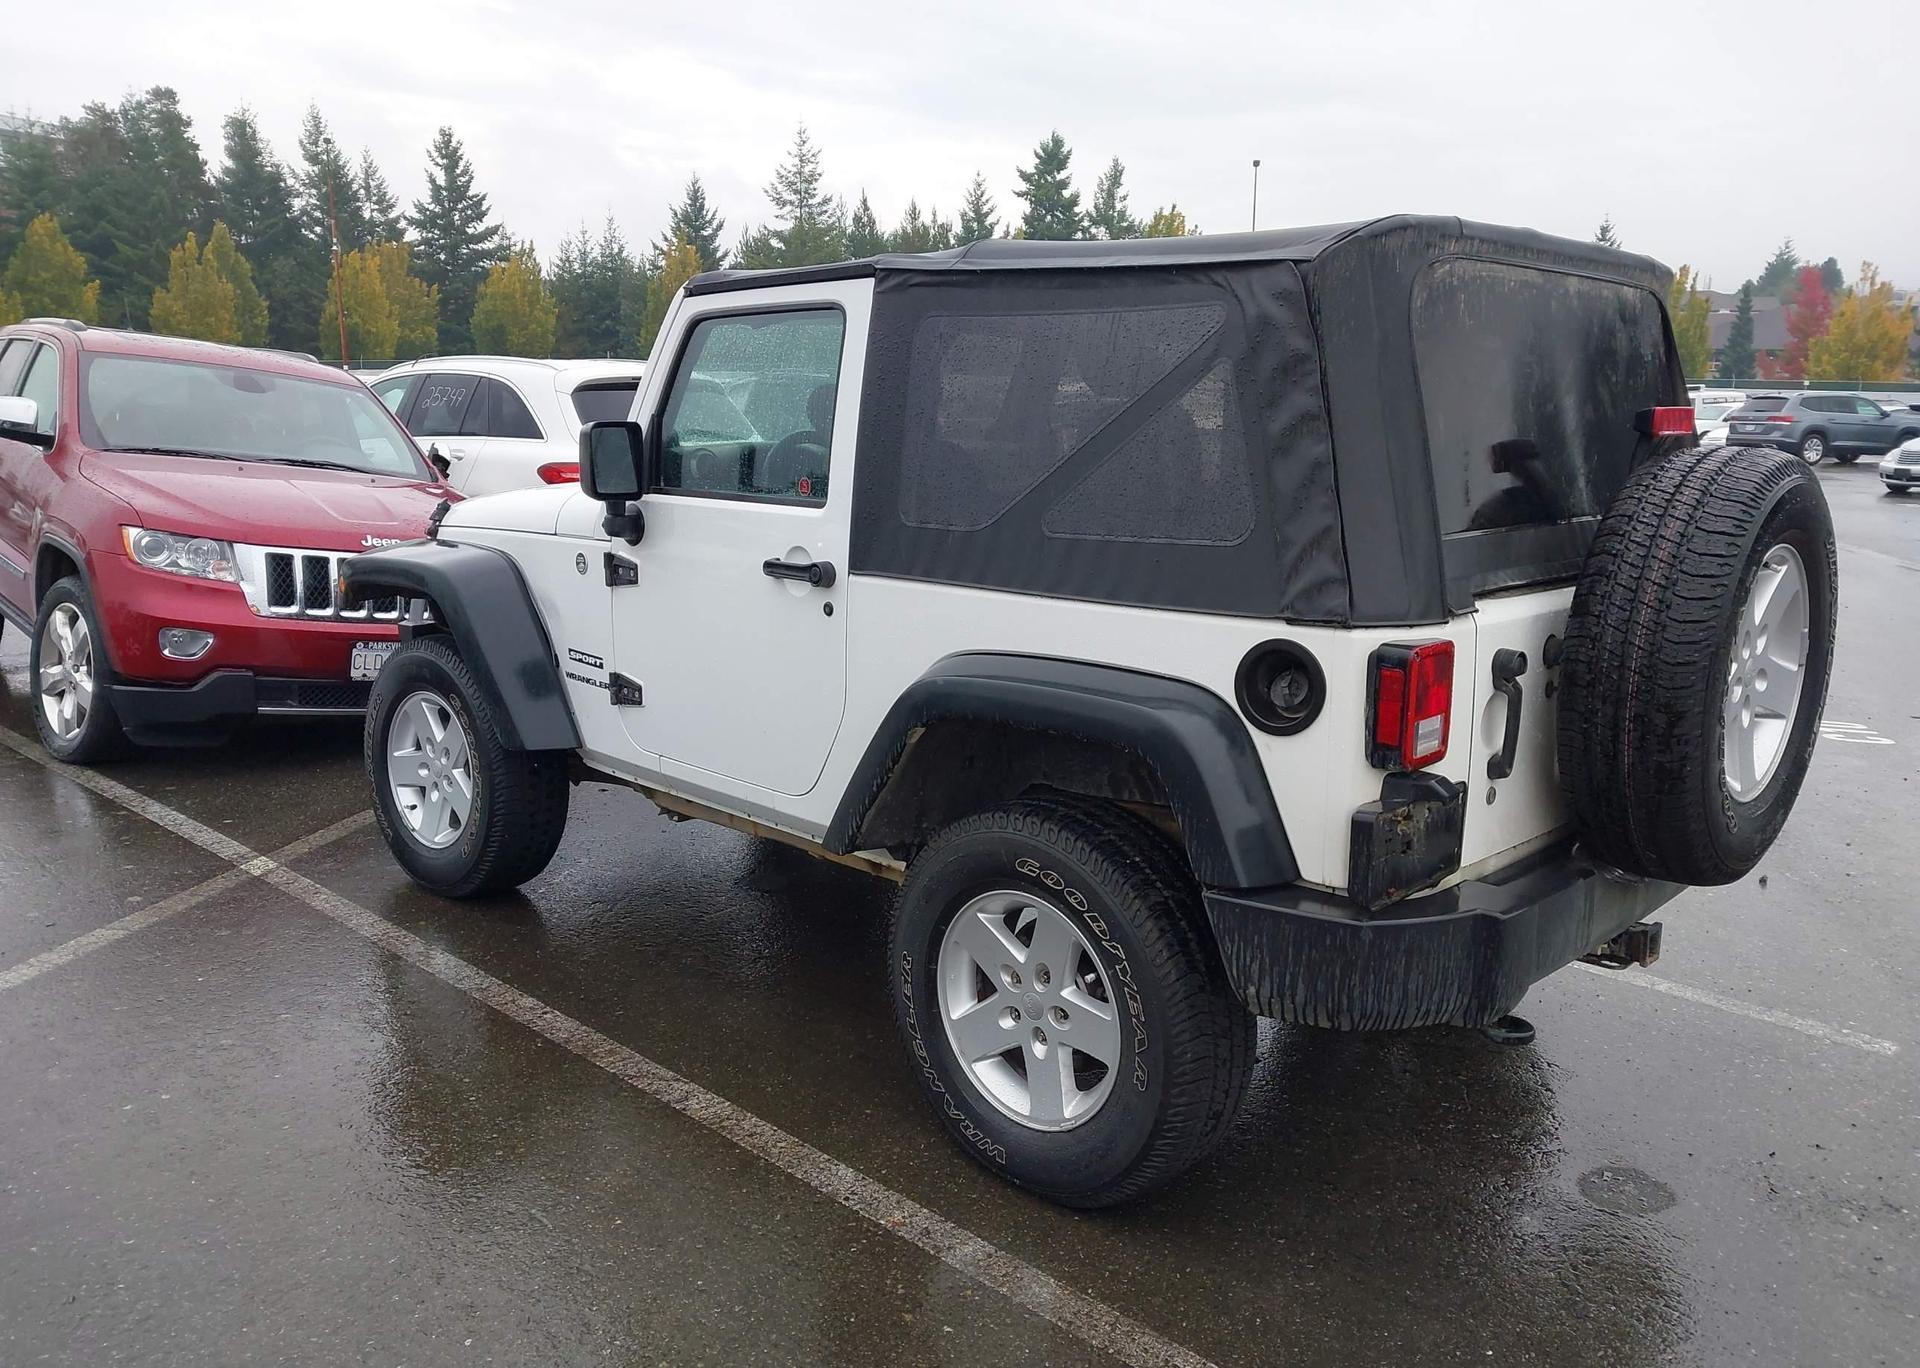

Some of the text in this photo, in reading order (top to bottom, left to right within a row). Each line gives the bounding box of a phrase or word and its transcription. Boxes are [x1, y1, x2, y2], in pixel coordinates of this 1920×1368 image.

[565, 670, 611, 692] WRANGLER
[569, 649, 604, 668] SPORT
[1015, 857, 1150, 1092] GOODYEAR
[902, 950, 1006, 1165] WRANGLER
